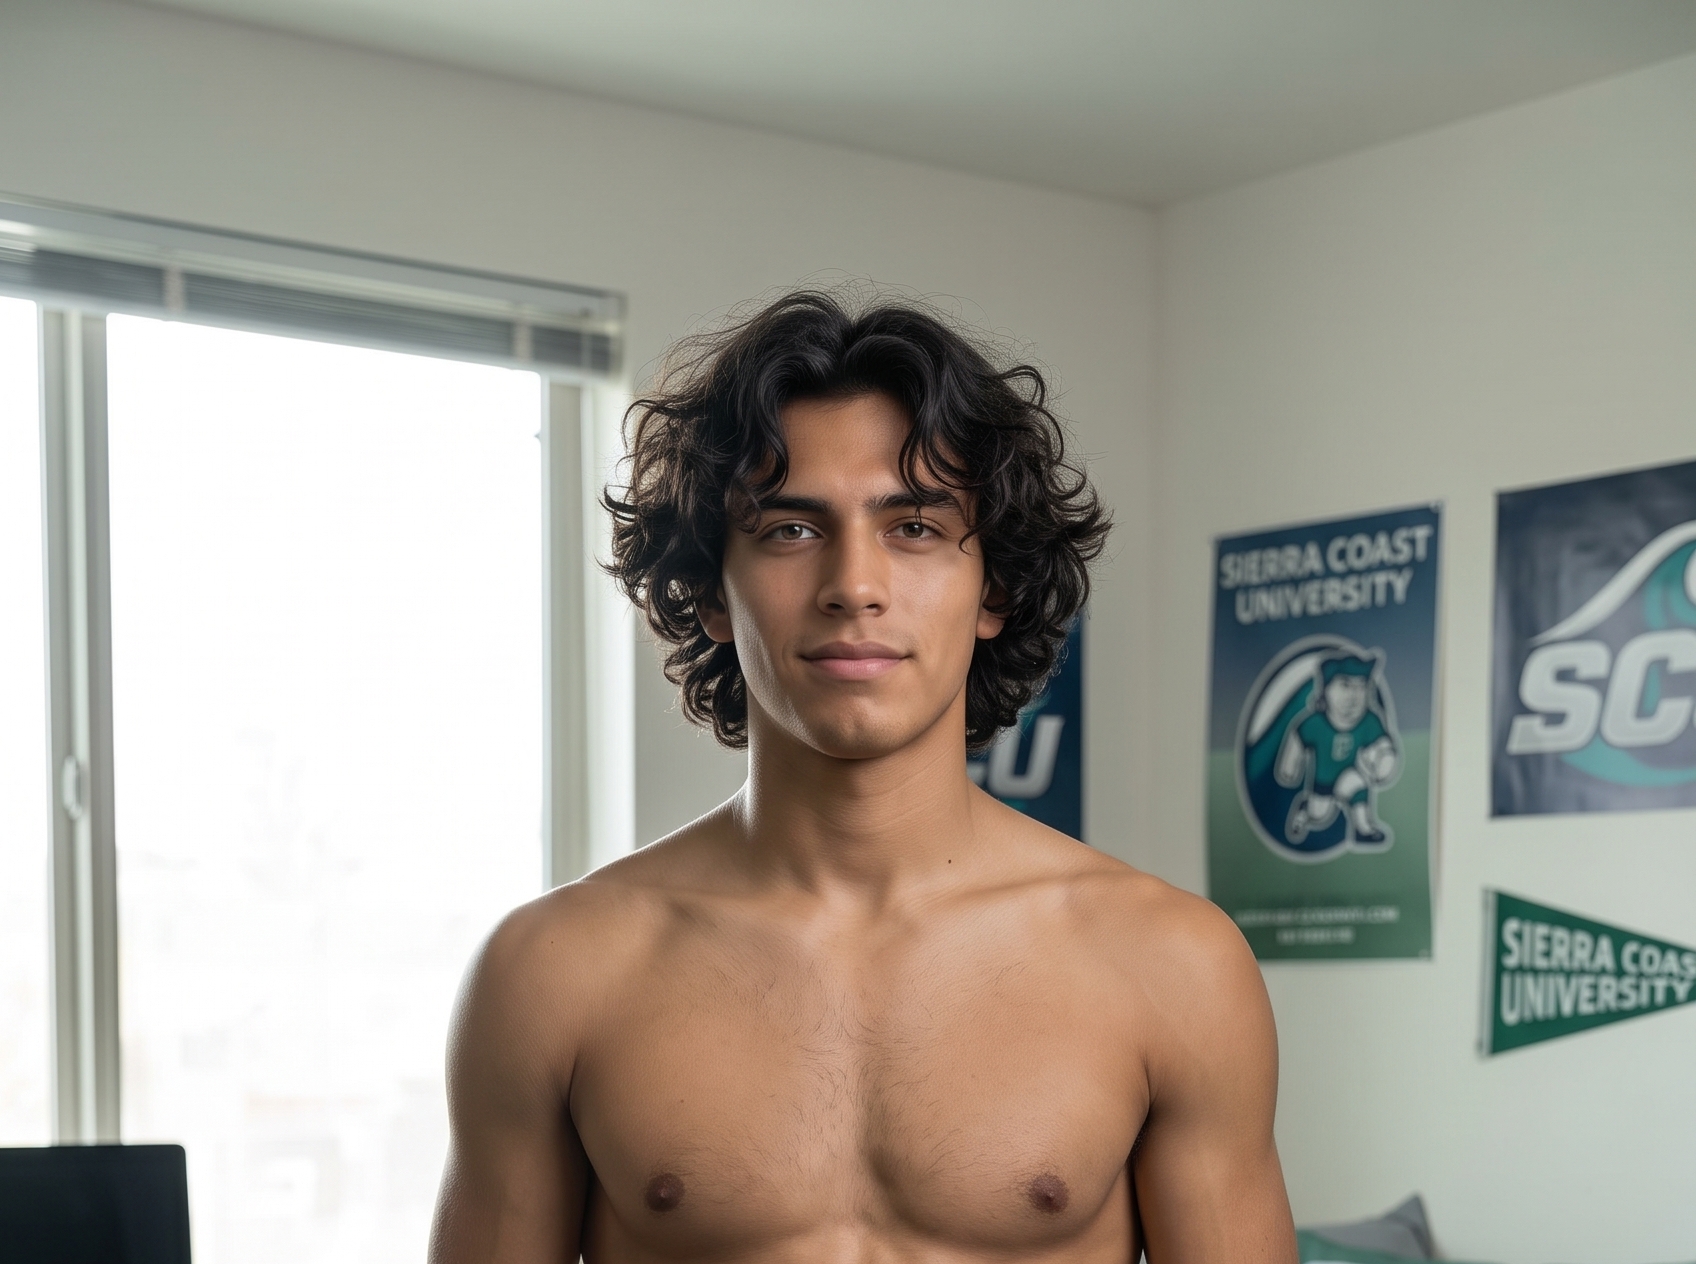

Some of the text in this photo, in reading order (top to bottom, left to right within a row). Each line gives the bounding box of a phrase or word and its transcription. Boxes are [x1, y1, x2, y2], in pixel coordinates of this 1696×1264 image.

[1219, 524, 1434, 590] SIERRA COAST
[1235, 567, 1413, 625] UNIVERSITY
[1507, 628, 1696, 755] SC
[1502, 916, 1617, 974] SIERRA
[1502, 971, 1692, 1026] UNIVERSITY
